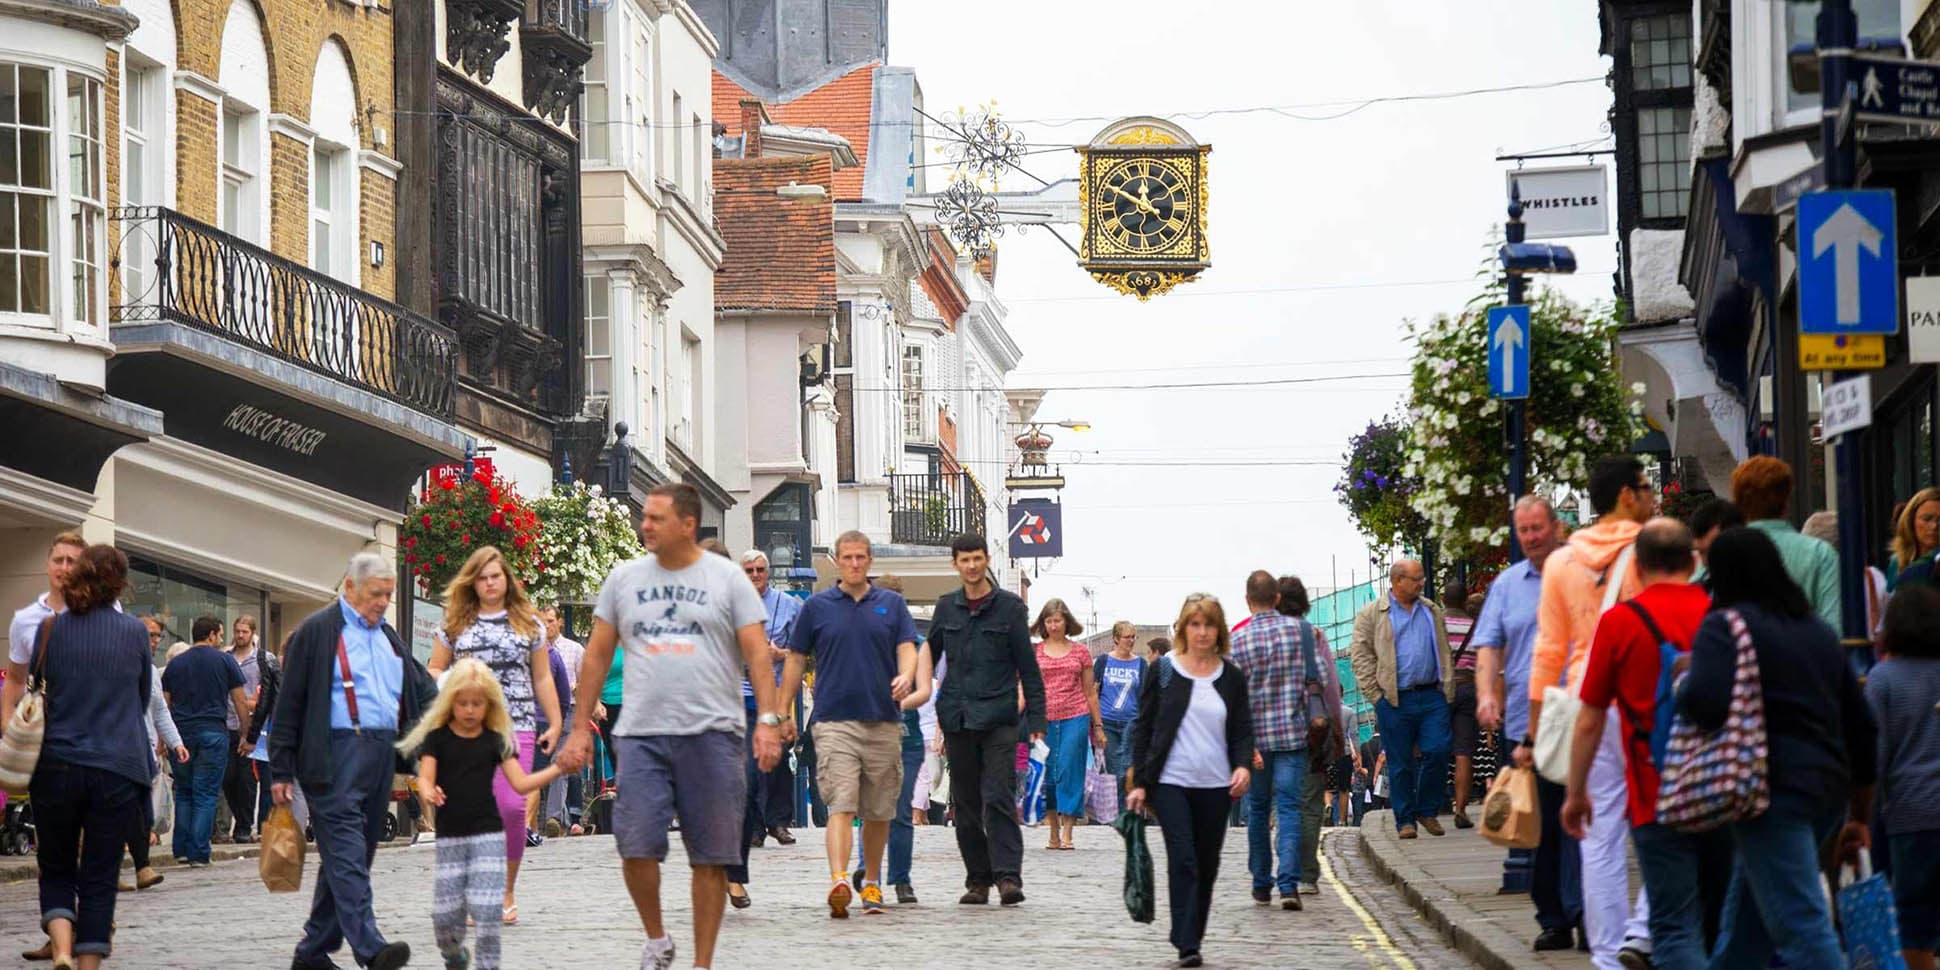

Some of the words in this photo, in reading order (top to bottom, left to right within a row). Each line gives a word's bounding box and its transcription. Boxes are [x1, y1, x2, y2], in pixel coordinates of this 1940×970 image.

[1520, 196, 1599, 209] WHISTLES
[1911, 311, 1940, 326] PA
[223, 403, 273, 438] HOUSE
[260, 418, 289, 443] OF
[275, 422, 327, 456] FRASER
[636, 586, 707, 606] KANGOL
[1104, 667, 1140, 680] LUCKY
[1110, 677, 1133, 709] 7
